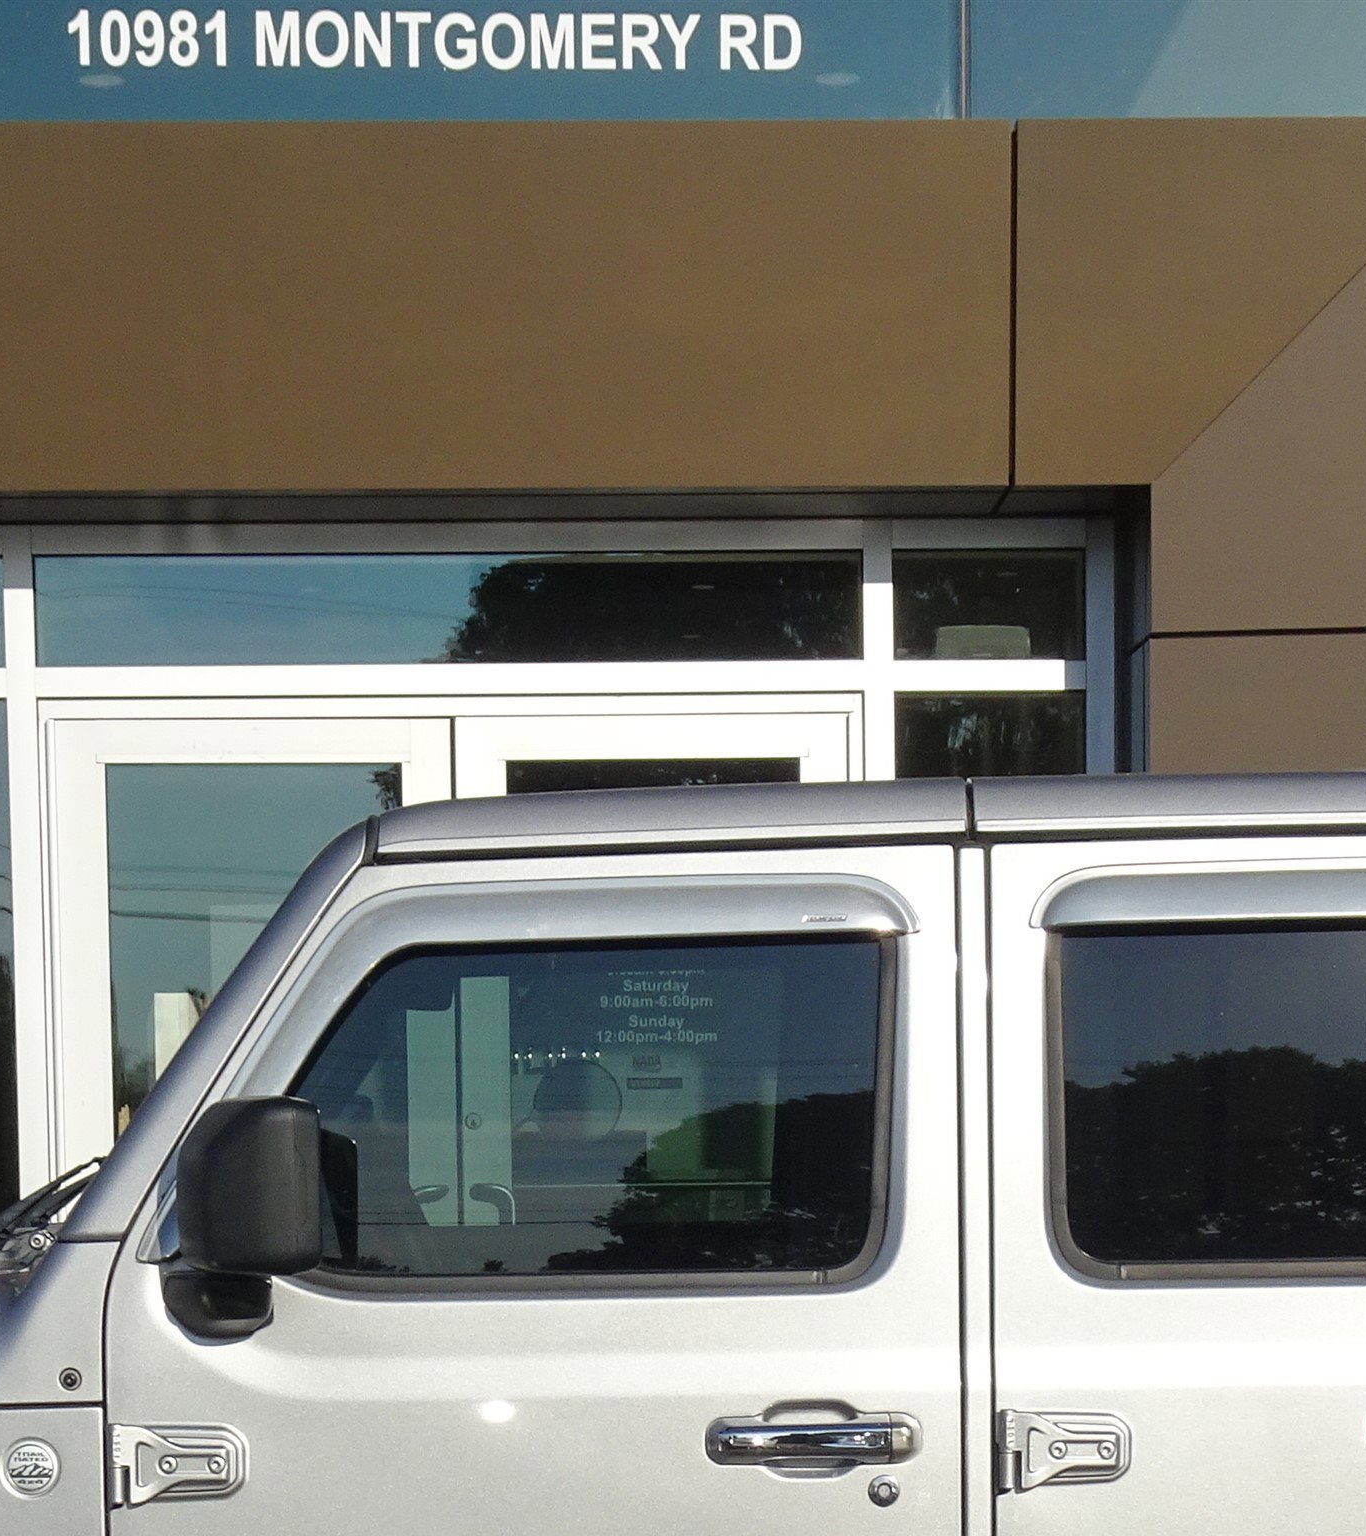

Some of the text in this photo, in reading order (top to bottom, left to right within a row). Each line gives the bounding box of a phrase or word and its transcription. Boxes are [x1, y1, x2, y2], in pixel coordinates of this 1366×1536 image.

[66, 9, 802, 71] 10981 MONTGOMERY RD
[623, 979, 689, 994] Saturday
[628, 1015, 685, 1029] Sunday
